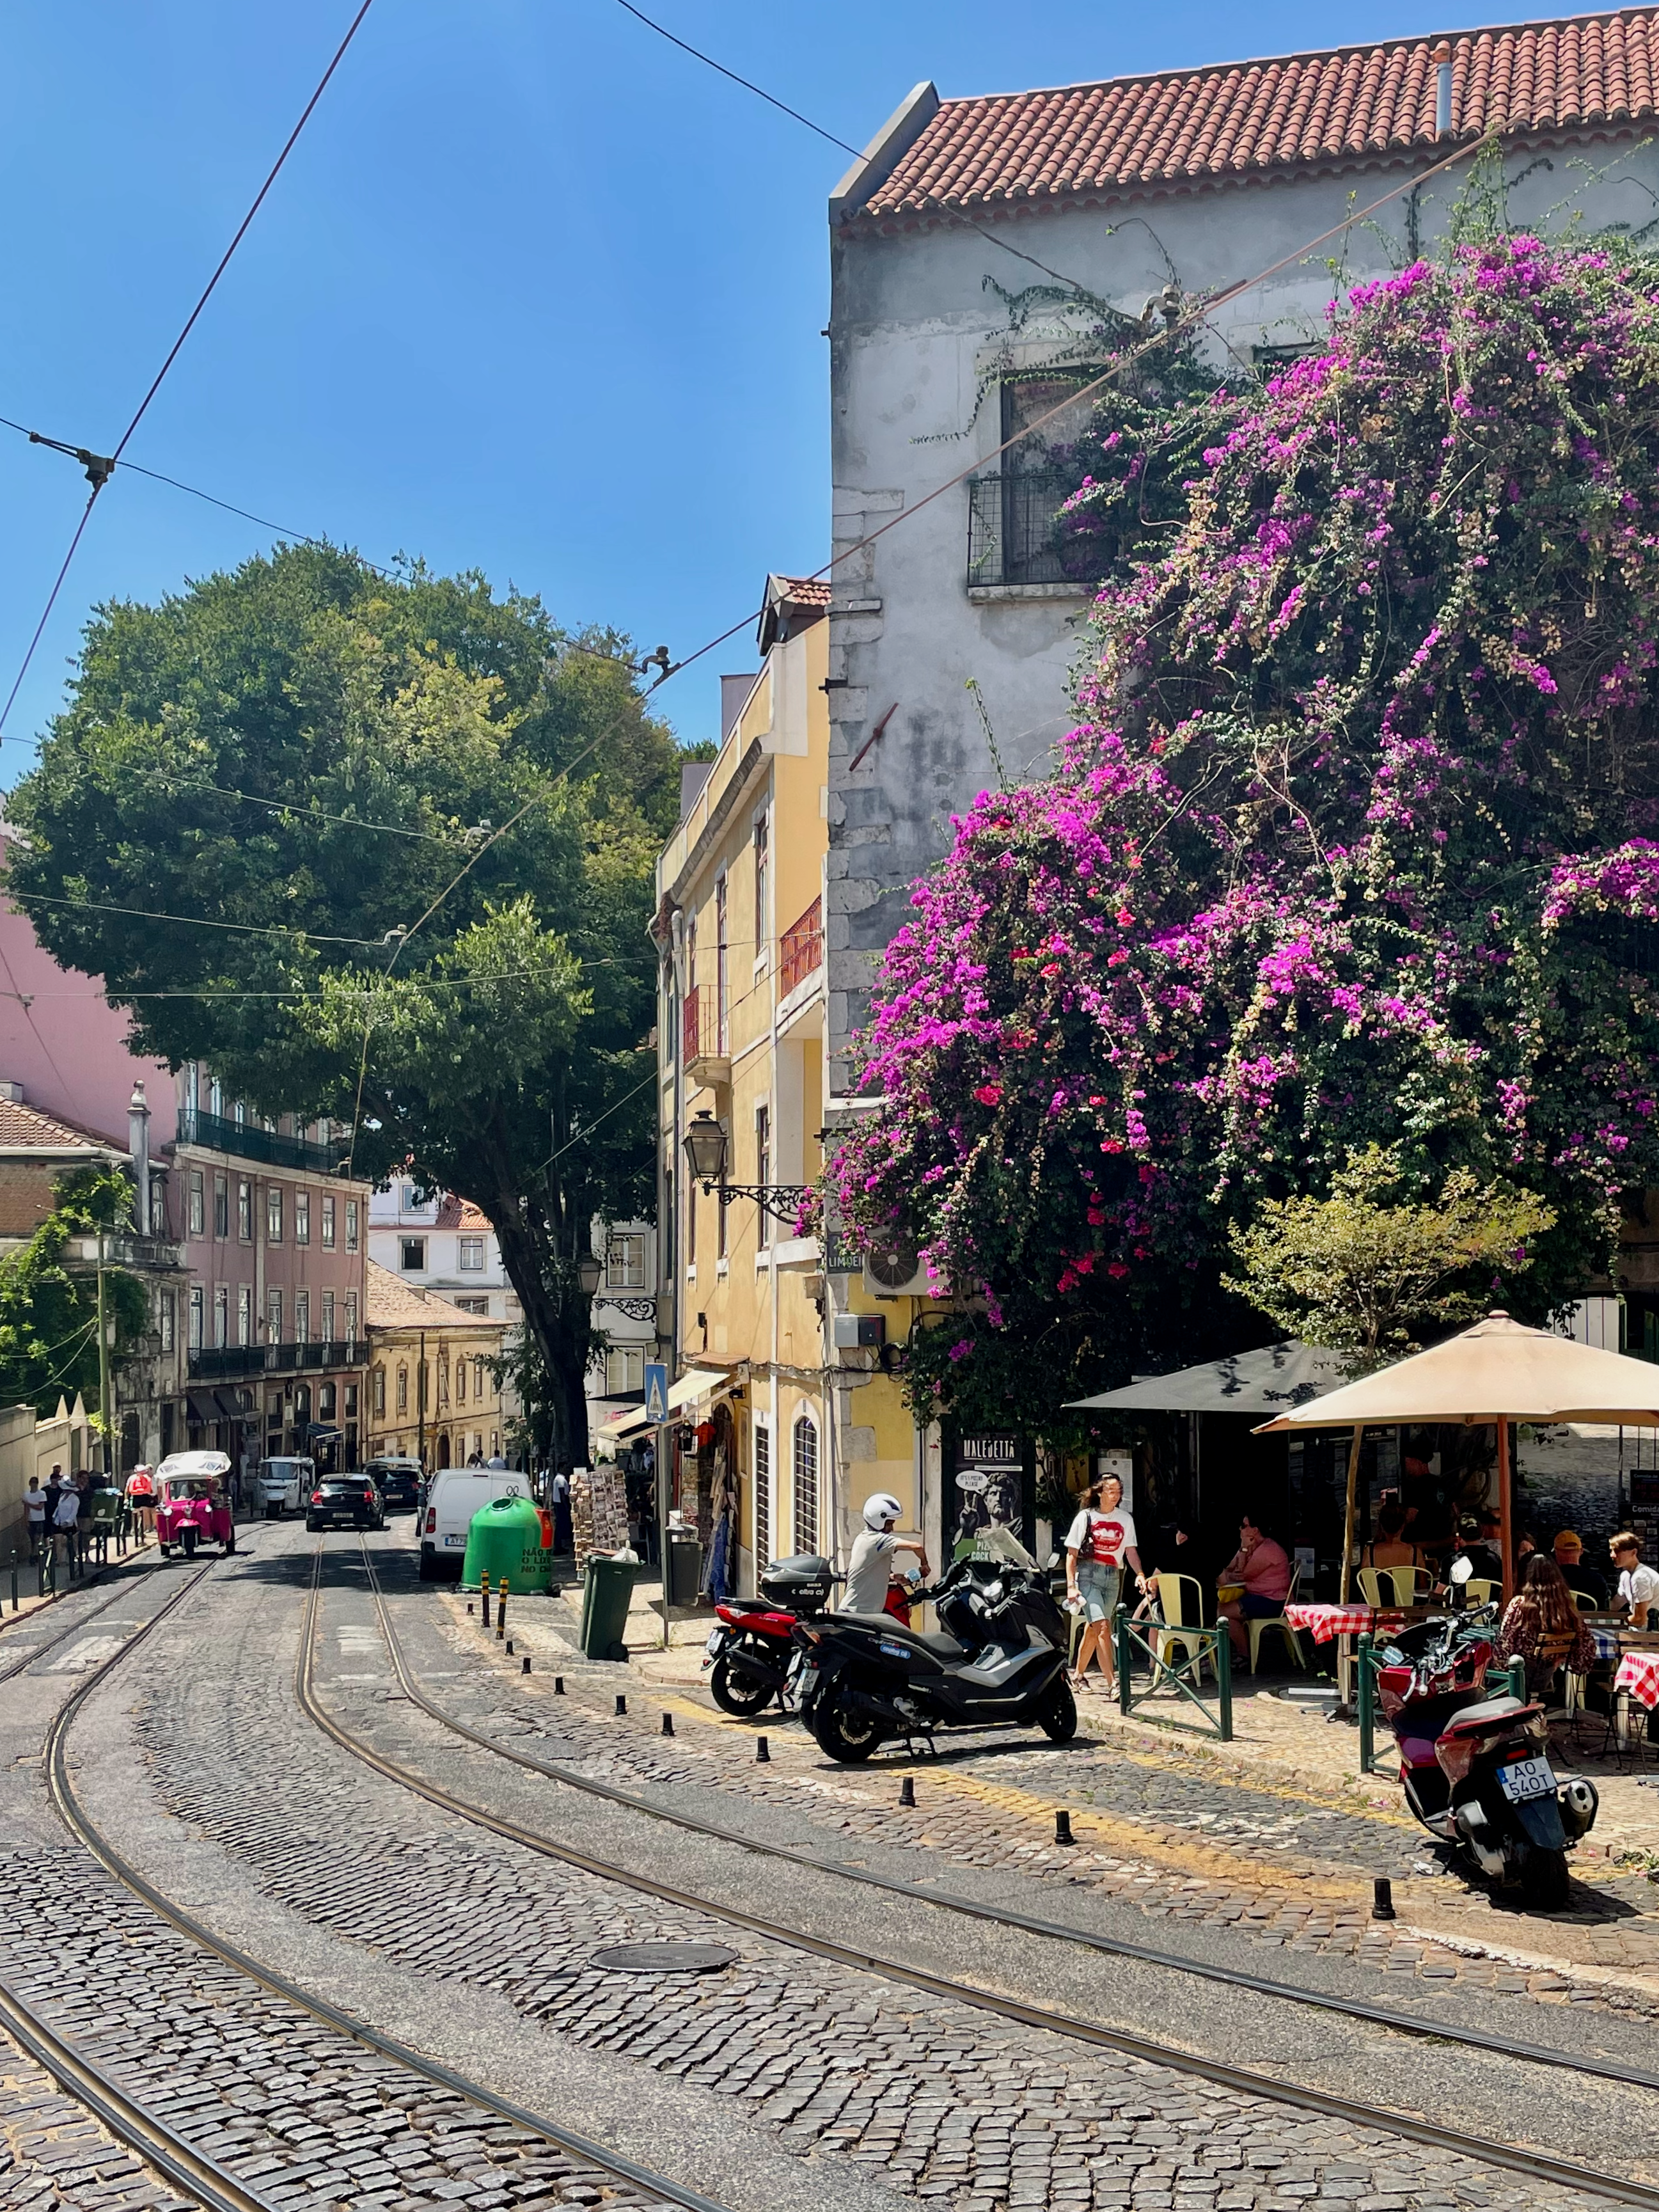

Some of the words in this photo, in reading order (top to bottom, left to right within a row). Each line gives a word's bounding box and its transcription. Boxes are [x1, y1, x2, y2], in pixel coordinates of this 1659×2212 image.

[964, 1439, 1015, 1458] MALEDETTA
[523, 1547, 544, 1556] NÃO
[1514, 1762, 1536, 1780] AO
